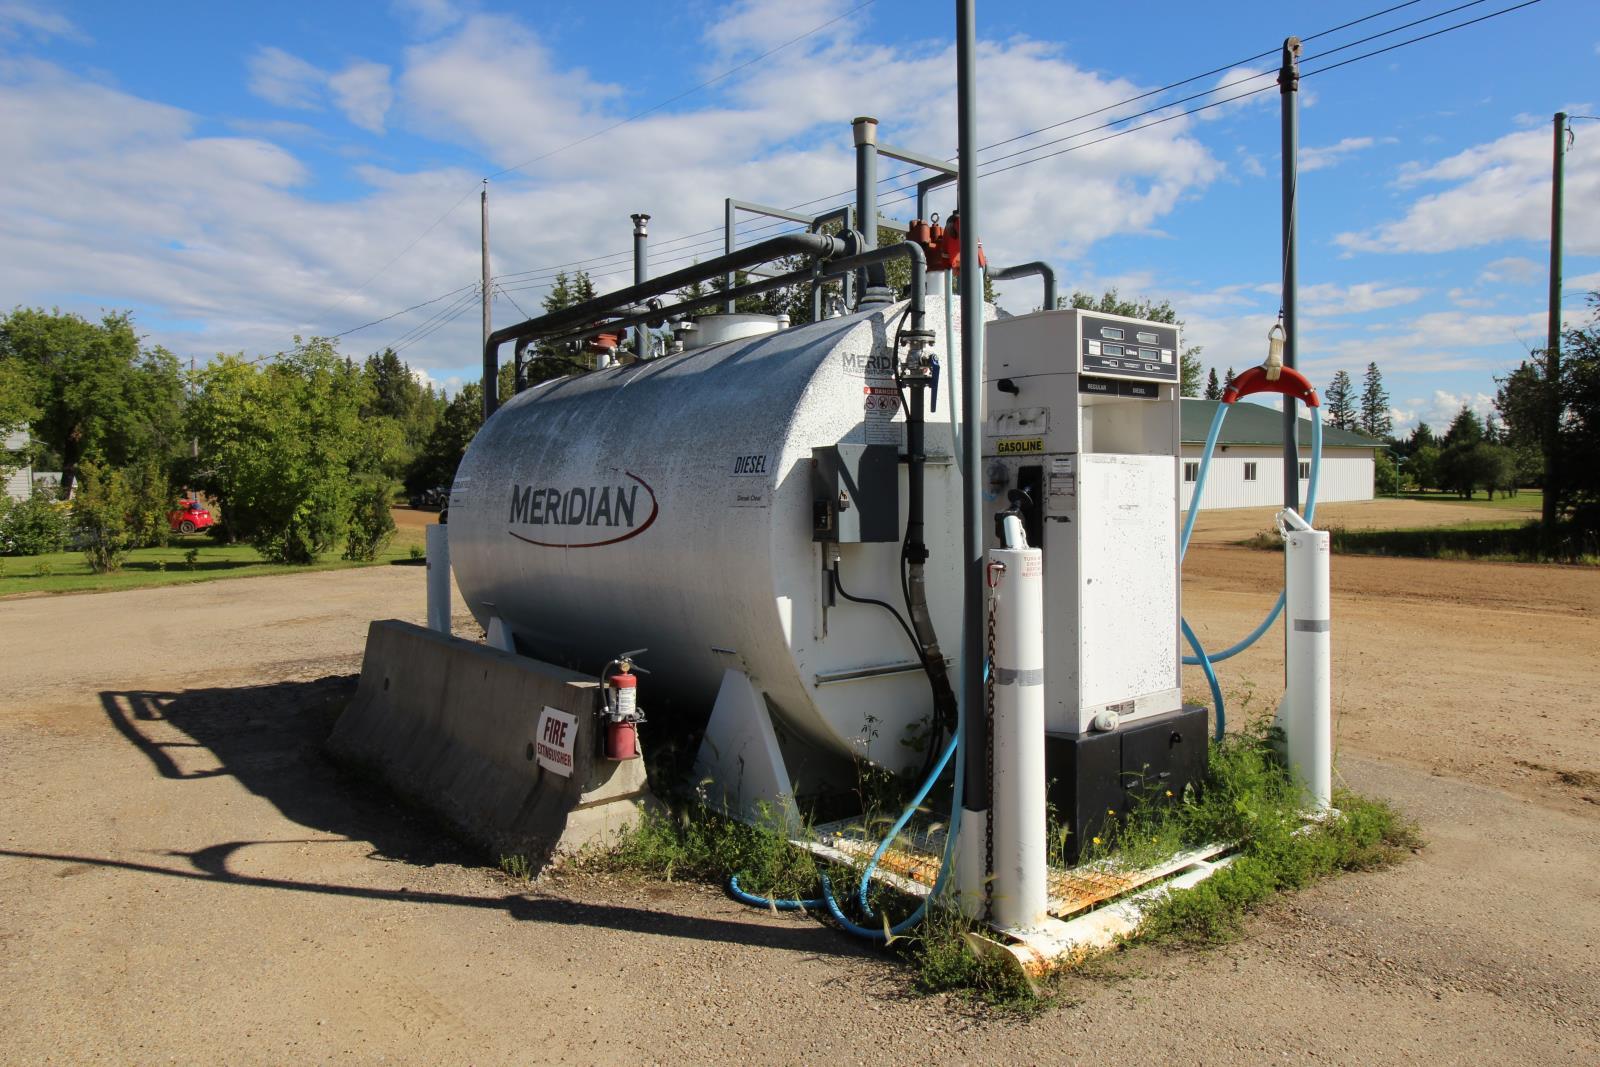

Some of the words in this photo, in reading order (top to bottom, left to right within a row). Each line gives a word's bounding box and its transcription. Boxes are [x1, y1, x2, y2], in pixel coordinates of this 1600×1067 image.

[1087, 382, 1107, 391] REGULAR
[998, 440, 1042, 452] GASOLINE
[733, 455, 767, 474] DIESEL
[509, 484, 639, 527] MERIDIAN
[543, 716, 569, 748] FIRE
[537, 742, 572, 767] EXTINGUISHER
